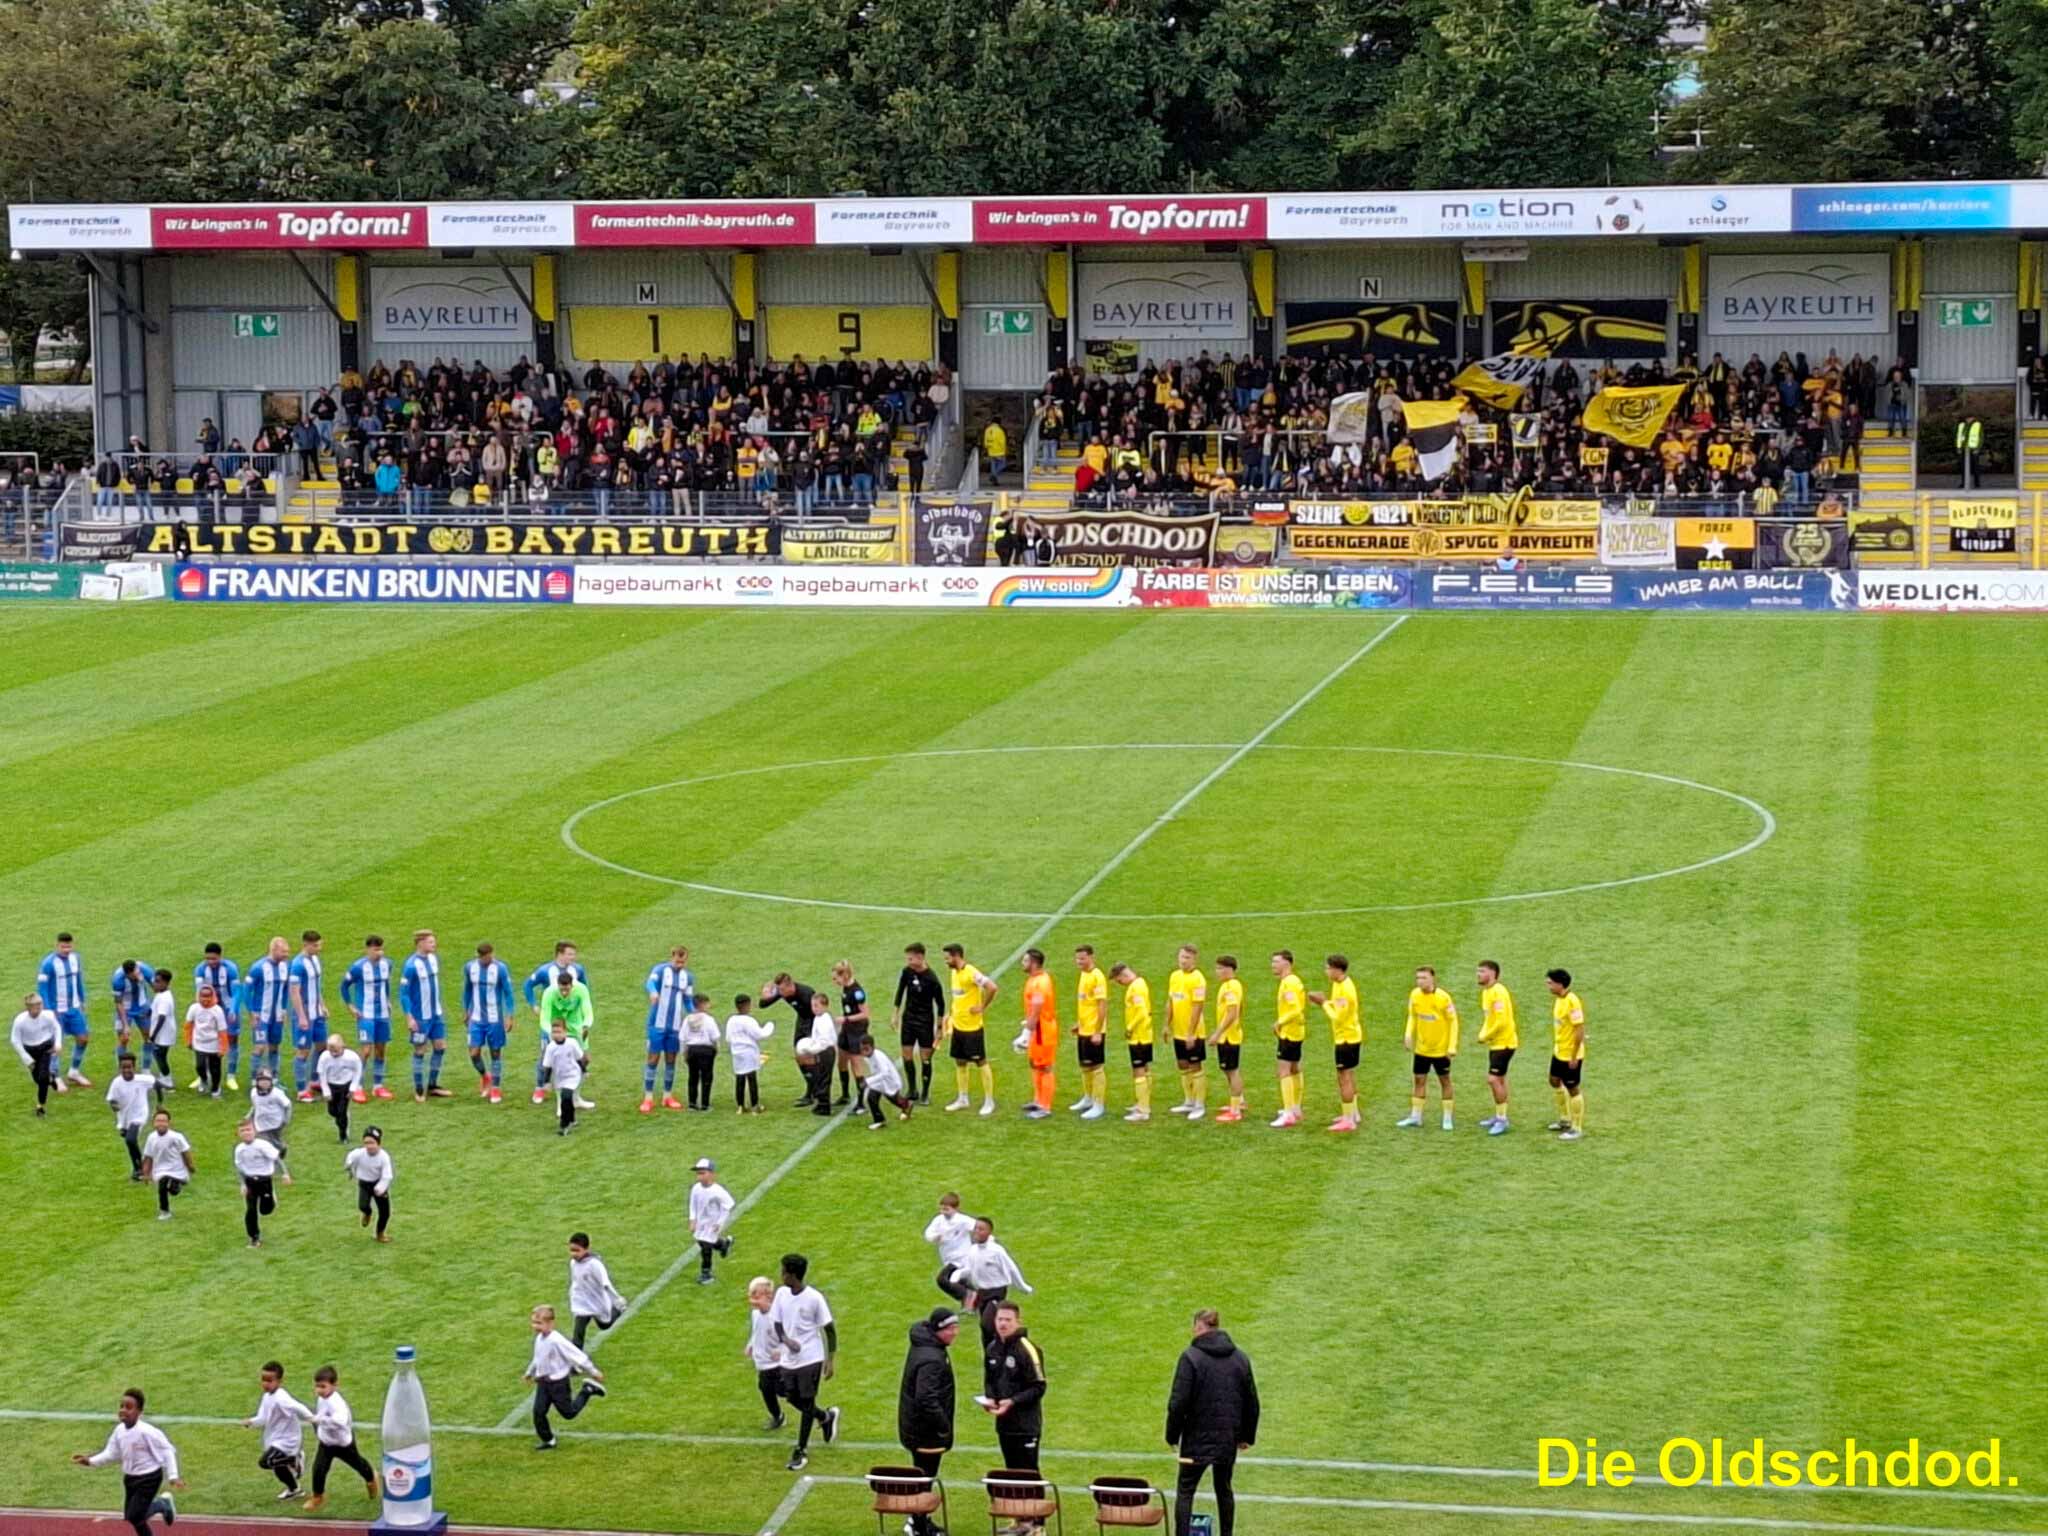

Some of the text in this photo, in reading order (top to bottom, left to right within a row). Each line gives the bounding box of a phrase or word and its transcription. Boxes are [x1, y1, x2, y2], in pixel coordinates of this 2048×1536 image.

[1441, 199, 1573, 217] motion
[165, 211, 411, 241] Wir bringen's in Topform!
[591, 213, 795, 229] formentechnik-bayreuth.de
[988, 204, 1249, 234] Wir bringen's in Topform!
[1440, 219, 1572, 231] FOR MAN AND MACHINE
[1688, 215, 1749, 226] schlaeger
[640, 286, 655, 301] M
[1364, 280, 1379, 296] N
[648, 315, 660, 353] 1
[838, 313, 861, 353] 9
[1296, 506, 1342, 524] SZENE
[1373, 506, 1407, 524] 1921
[1046, 523, 1207, 551] LDSCHDOD
[1699, 523, 1733, 534] FORZA
[149, 525, 417, 553] ALTSTADT
[485, 526, 769, 554] BAYREUTH
[1294, 534, 1410, 549] GEGENGERADE
[1445, 535, 1498, 549] SPVGG
[1509, 534, 1595, 550] BAYREUTH
[803, 546, 869, 559] LAINECK
[1053, 553, 1125, 567] ALTSTADT
[208, 568, 540, 598] FRANKEN BRUNNEN
[578, 576, 721, 595] hagebaumarkt
[782, 577, 928, 596] hagebaumarkt
[1142, 574, 1399, 593] FARBE IST UNSER LEBEN.
[1640, 574, 1803, 601] IMMER AM BALL!
[1208, 592, 1333, 604] www.swcolor.de
[1863, 584, 2044, 601] WEDLICH.COM
